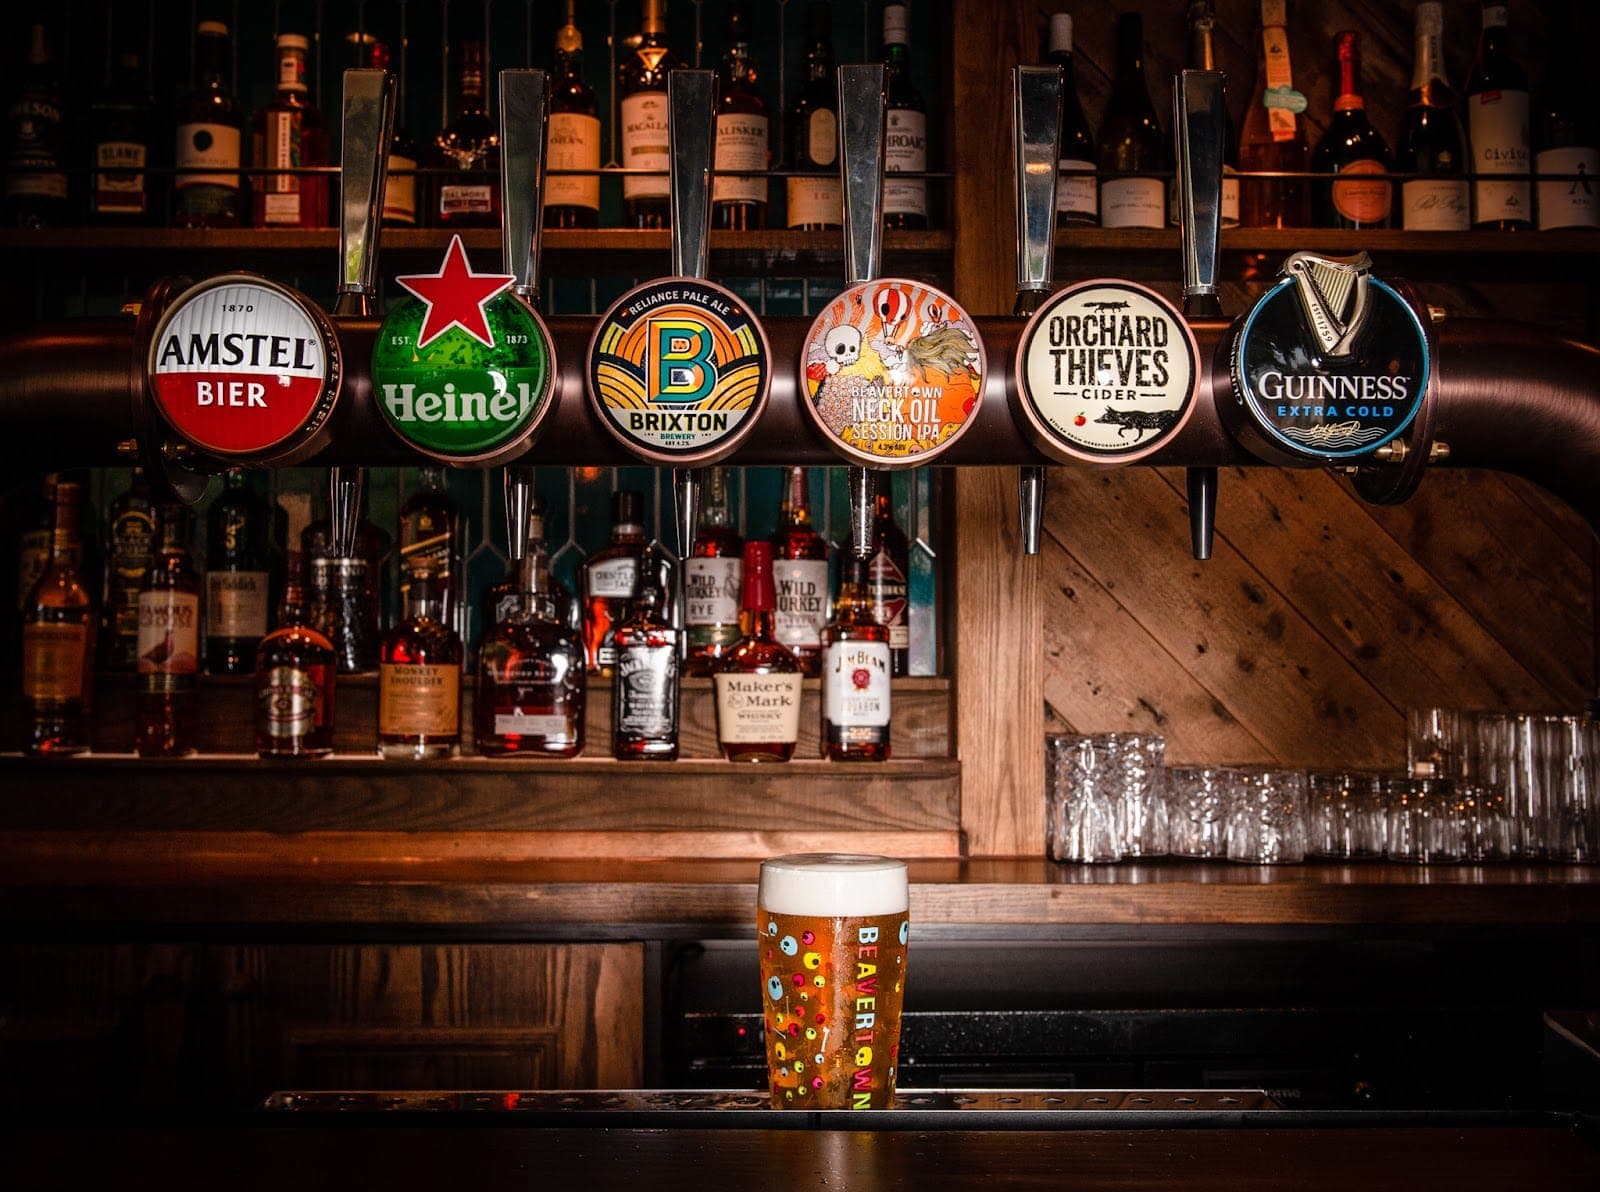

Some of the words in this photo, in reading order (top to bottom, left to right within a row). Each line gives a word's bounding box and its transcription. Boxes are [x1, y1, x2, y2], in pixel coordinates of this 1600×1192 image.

[626, 122, 669, 133] MACALLA
[718, 126, 764, 137] ALISKER
[222, 304, 254, 313] 1870
[628, 290, 680, 316] RELIANCE
[682, 290, 710, 304] PALE
[710, 299, 731, 316] ALE
[1049, 314, 1169, 347] ORCHARD
[1317, 320, 1333, 341] 1759
[392, 336, 413, 346] EST.
[506, 335, 528, 345] 1873
[159, 333, 315, 370] AMSTEL
[646, 317, 718, 404] B
[1049, 348, 1170, 387] THIEVES
[851, 386, 943, 399] BEAVERTOWN
[1258, 371, 1408, 400] GUINNESS
[197, 381, 268, 408] BIER
[1081, 389, 1137, 401] CIDER
[852, 398, 905, 424] NECK
[910, 399, 942, 424] OIL
[1277, 406, 1338, 417] EXTRA
[1346, 406, 1394, 417] COLD
[630, 412, 728, 431] BRIXTON
[852, 423, 913, 441] SESSION
[917, 424, 940, 441] IPA
[595, 570, 635, 580] GENTLE
[690, 574, 716, 587] WILD
[688, 586, 720, 599] URKEY
[780, 580, 816, 596] WILD
[690, 604, 714, 615] RYE
[778, 596, 821, 612] URKEY
[727, 681, 793, 692] Maker's
[746, 695, 792, 707] Mark
[853, 926, 879, 1110] BEAVERTOWN
